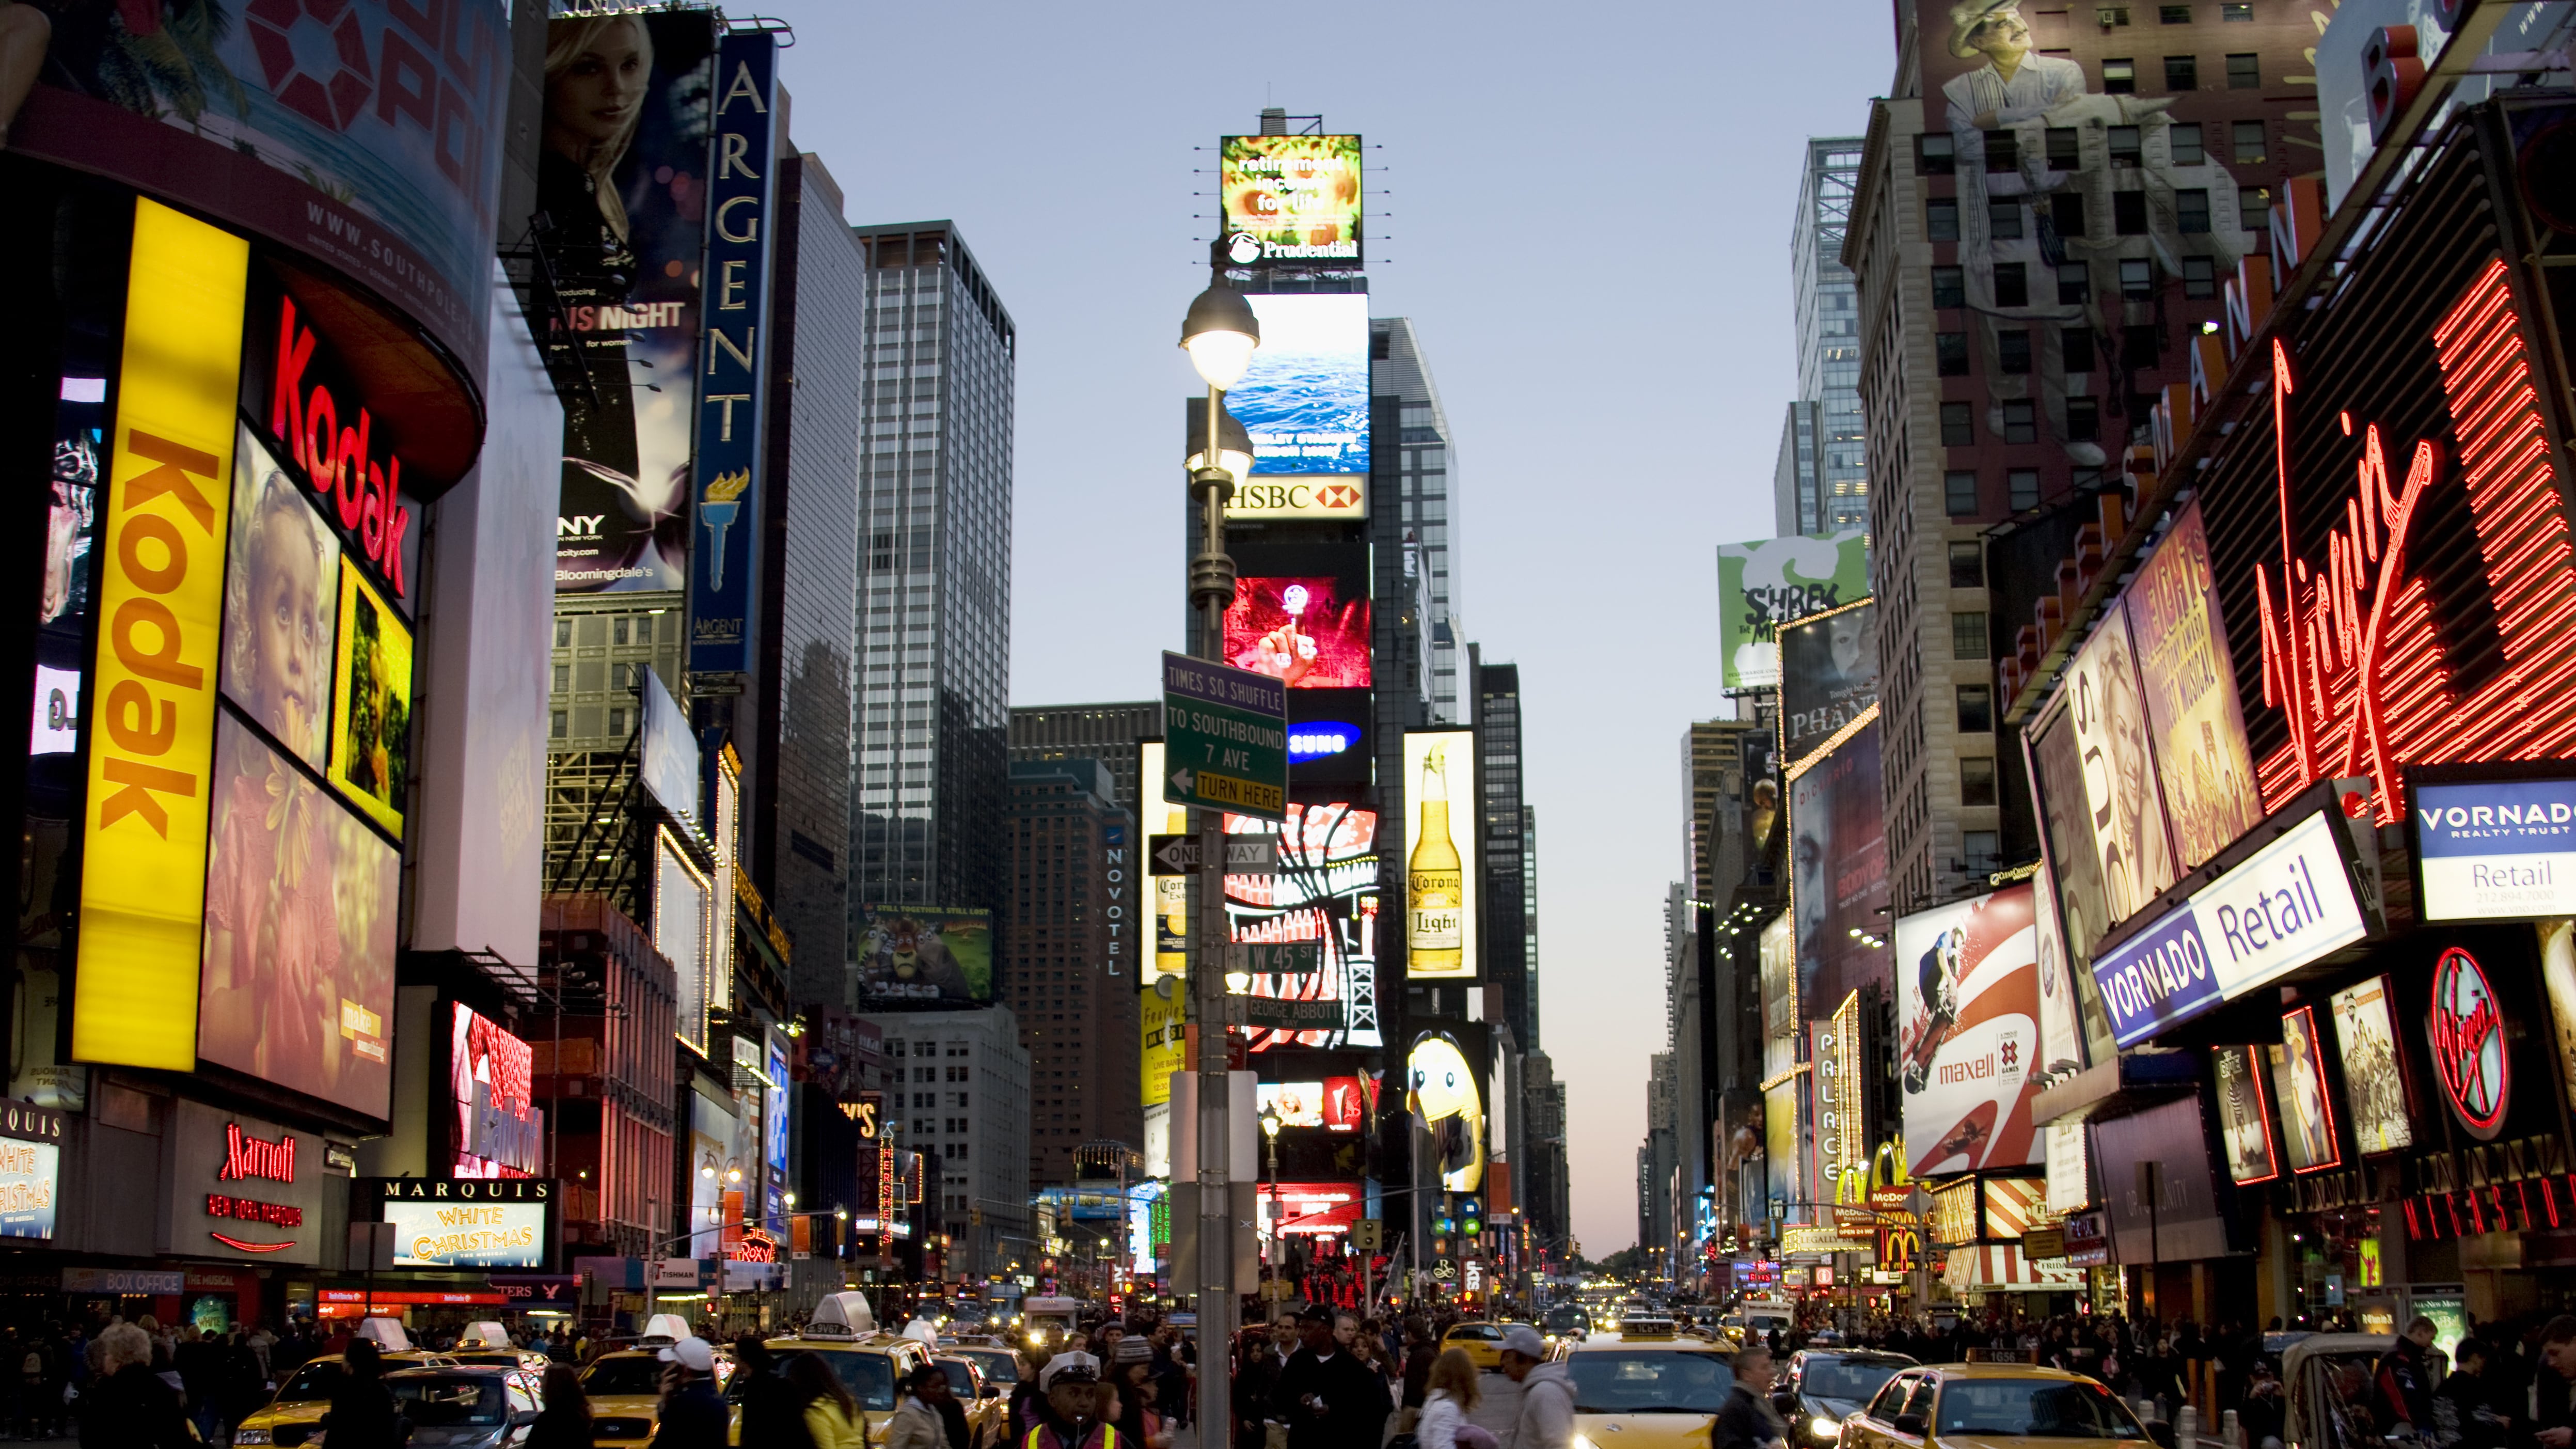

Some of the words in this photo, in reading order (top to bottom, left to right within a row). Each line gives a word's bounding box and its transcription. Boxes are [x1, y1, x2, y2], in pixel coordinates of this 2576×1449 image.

[1238, 155, 1343, 172] retirement
[1255, 175, 1325, 191] income
[1257, 194, 1284, 211] for
[1291, 194, 1325, 211] life
[705, 59, 768, 442] ARGENT
[1263, 240, 1357, 258] Prudential
[556, 288, 597, 297] roducing
[598, 301, 686, 330] NIGHT
[600, 339, 633, 347] women
[272, 293, 409, 600] Kodak
[2001, 178, 2299, 715] BERTELSMANN
[555, 566, 654, 582] Bloomingdale's
[100, 428, 220, 842] Kodak
[692, 617, 744, 635] ARGENT
[1168, 666, 1203, 693] TIMES
[1210, 676, 1225, 698] SQ
[1230, 684, 1282, 712] SHUFFLE
[1168, 705, 1187, 729] TO
[1192, 712, 1284, 750] SOUTHBOUND
[1205, 743, 1214, 763] 7
[1223, 748, 1250, 771] AVE
[1199, 775, 1238, 800] TURN
[1244, 784, 1280, 810] HERE
[2419, 803, 2576, 831] VORNAD
[2451, 828, 2510, 839] REALTY
[2517, 826, 2571, 836] TRUST
[1412, 874, 1460, 892] Corona
[2473, 860, 2552, 888] Retail
[1160, 878, 1186, 893] Cor
[969, 907, 989, 916] LOST
[1106, 848, 1123, 976] NOVOTEL
[2217, 854, 2325, 964] Retail
[2477, 903, 2556, 915] www.vno.com
[1416, 912, 1456, 933] Light
[1253, 948, 1267, 970] W
[1273, 947, 1293, 969] 45
[1301, 946, 1314, 958] ST
[2100, 929, 2206, 1031] VORNADO
[344, 1003, 372, 1033] make
[1250, 1000, 1288, 1018] GEORGE
[1292, 1003, 1339, 1019] ABBOTT
[1281, 1019, 1299, 1028] WAY
[357, 1040, 385, 1062] something
[1940, 1053, 1995, 1085] maxell
[1819, 1033, 1838, 1181] PALACE
[479, 1083, 520, 1169] Bank
[217, 1122, 296, 1184] Marriott
[385, 1183, 547, 1198] MARQUIS
[209, 1194, 231, 1217] NEW
[262, 1202, 302, 1228] MARQUIS
[437, 1206, 504, 1228] WHITE
[413, 1226, 533, 1261] CHRISTMAS
[1801, 1236, 1838, 1244] LEGALLY
[17, 1275, 58, 1287] OFFICE
[107, 1273, 134, 1290] BOX
[136, 1274, 179, 1292] OFFICE
[187, 1274, 201, 1286] THE
[201, 1275, 235, 1286] MUSICAL
[817, 1324, 839, 1334] 9V67
